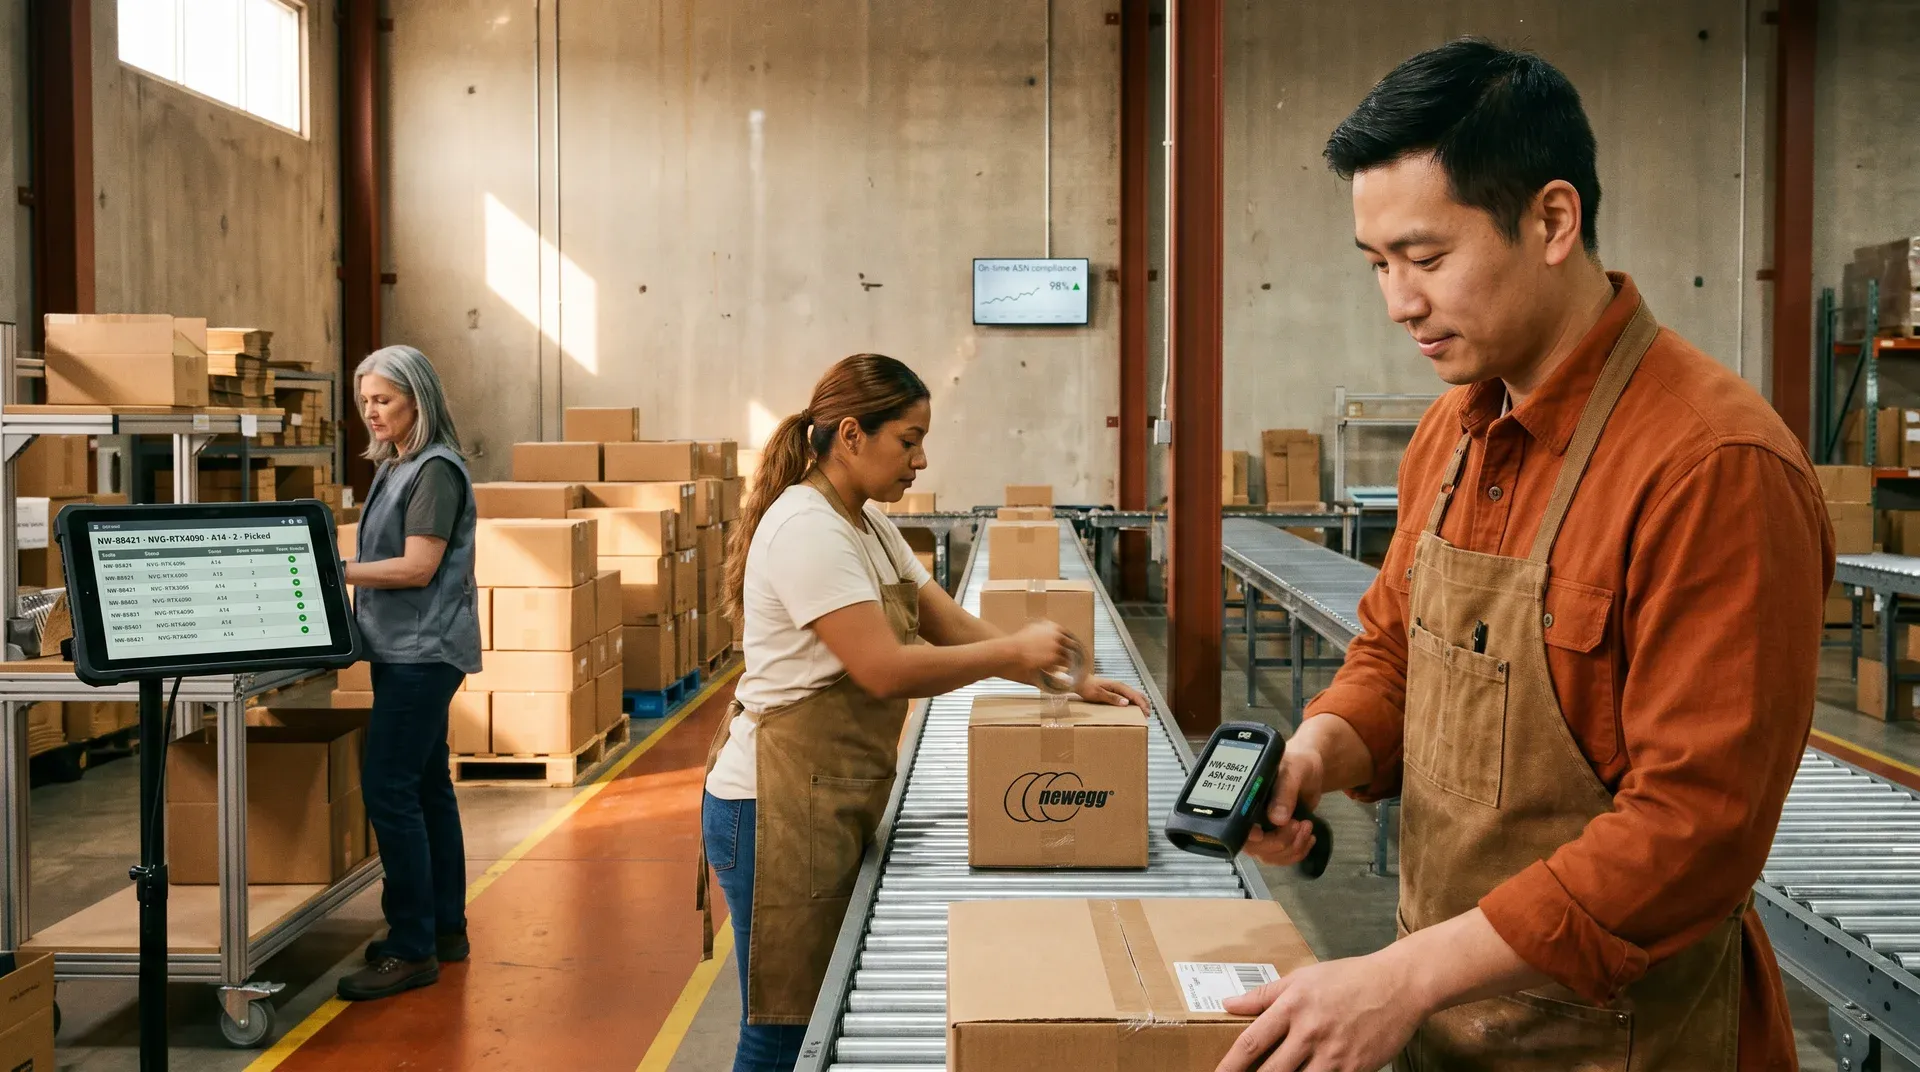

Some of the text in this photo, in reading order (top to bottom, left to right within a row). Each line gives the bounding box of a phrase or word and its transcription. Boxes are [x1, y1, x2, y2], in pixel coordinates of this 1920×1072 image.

[1012, 264, 1030, 272] ASN
[1031, 264, 1077, 273] compliance
[1049, 281, 1069, 290] 98%
[97, 535, 141, 545] NW-88421
[148, 534, 205, 543] NVG-RTX4090
[244, 532, 271, 540] Picked
[1208, 770, 1242, 783] ASN sent
